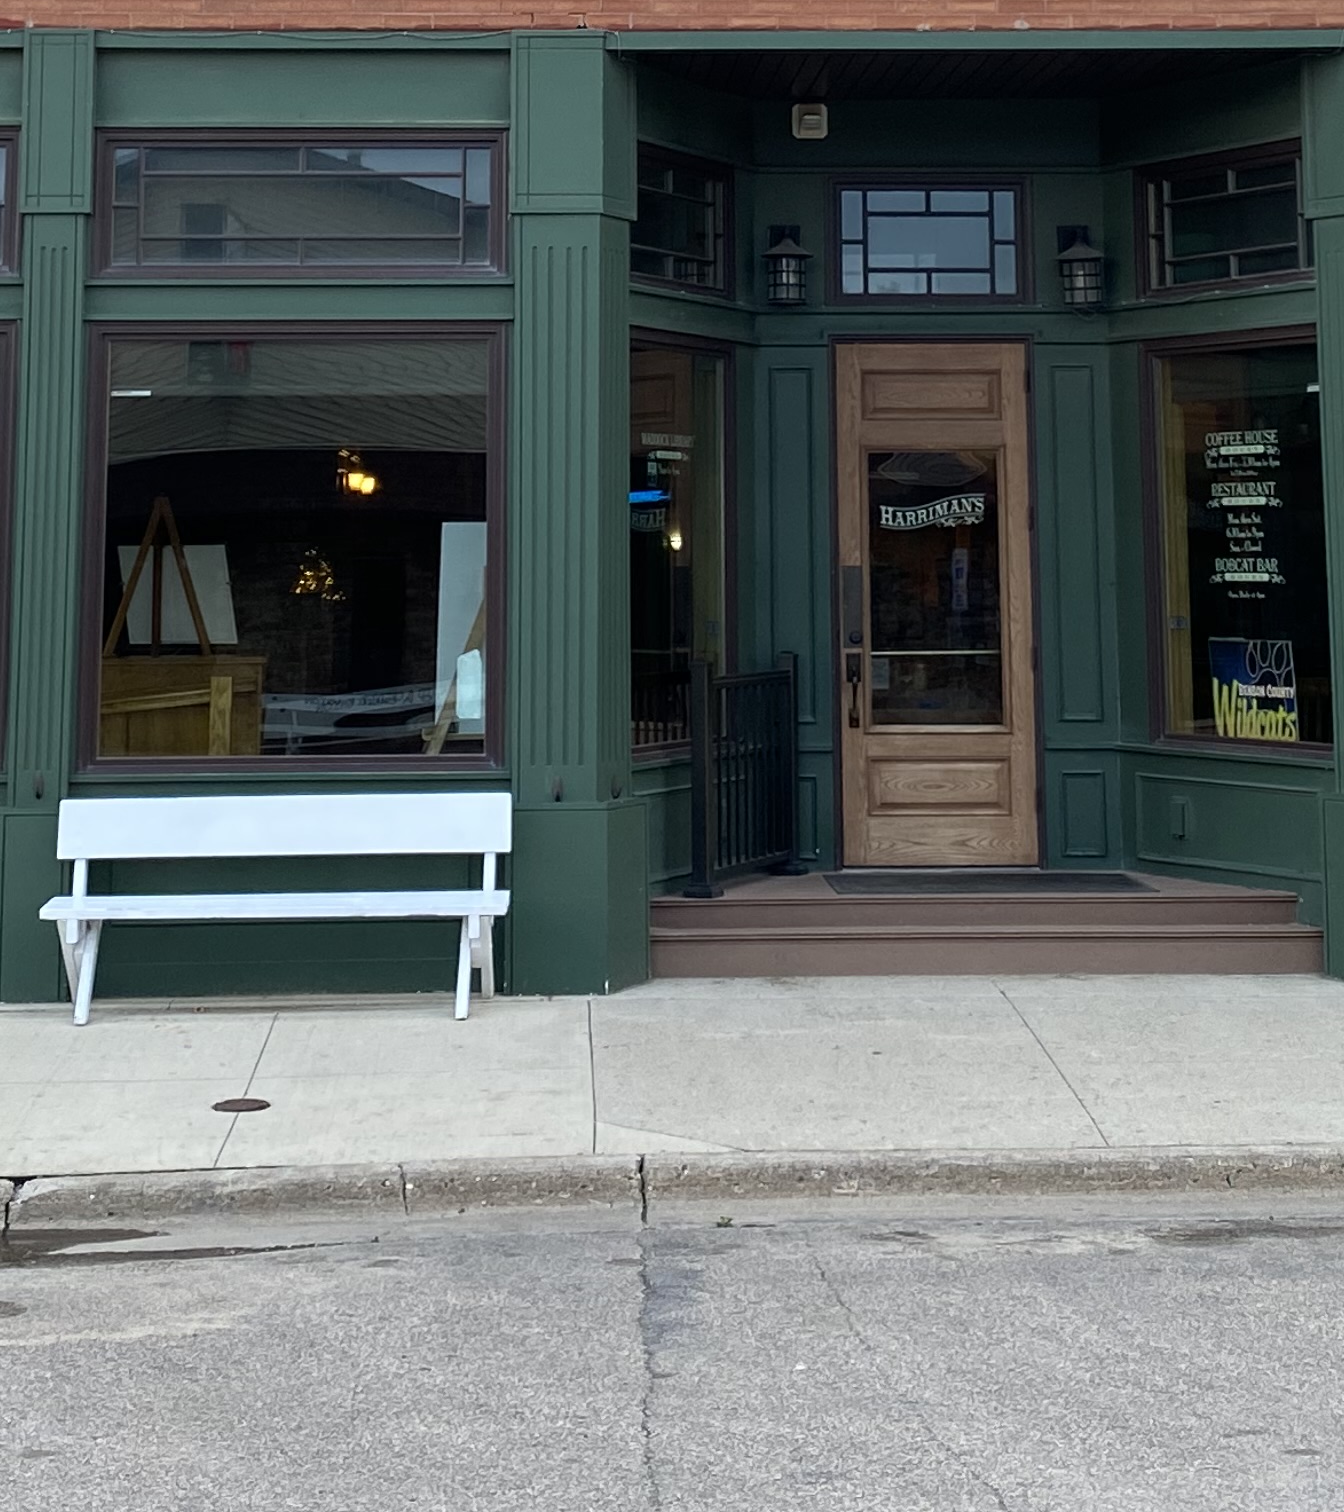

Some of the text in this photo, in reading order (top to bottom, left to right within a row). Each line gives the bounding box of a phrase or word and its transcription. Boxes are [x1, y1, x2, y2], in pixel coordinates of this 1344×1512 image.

[1205, 429, 1278, 446] COFFEE HOUSE
[1211, 481, 1276, 497] RESTAURANT
[1256, 557, 1279, 573] BAR
[1212, 677, 1297, 742] Wildcats
